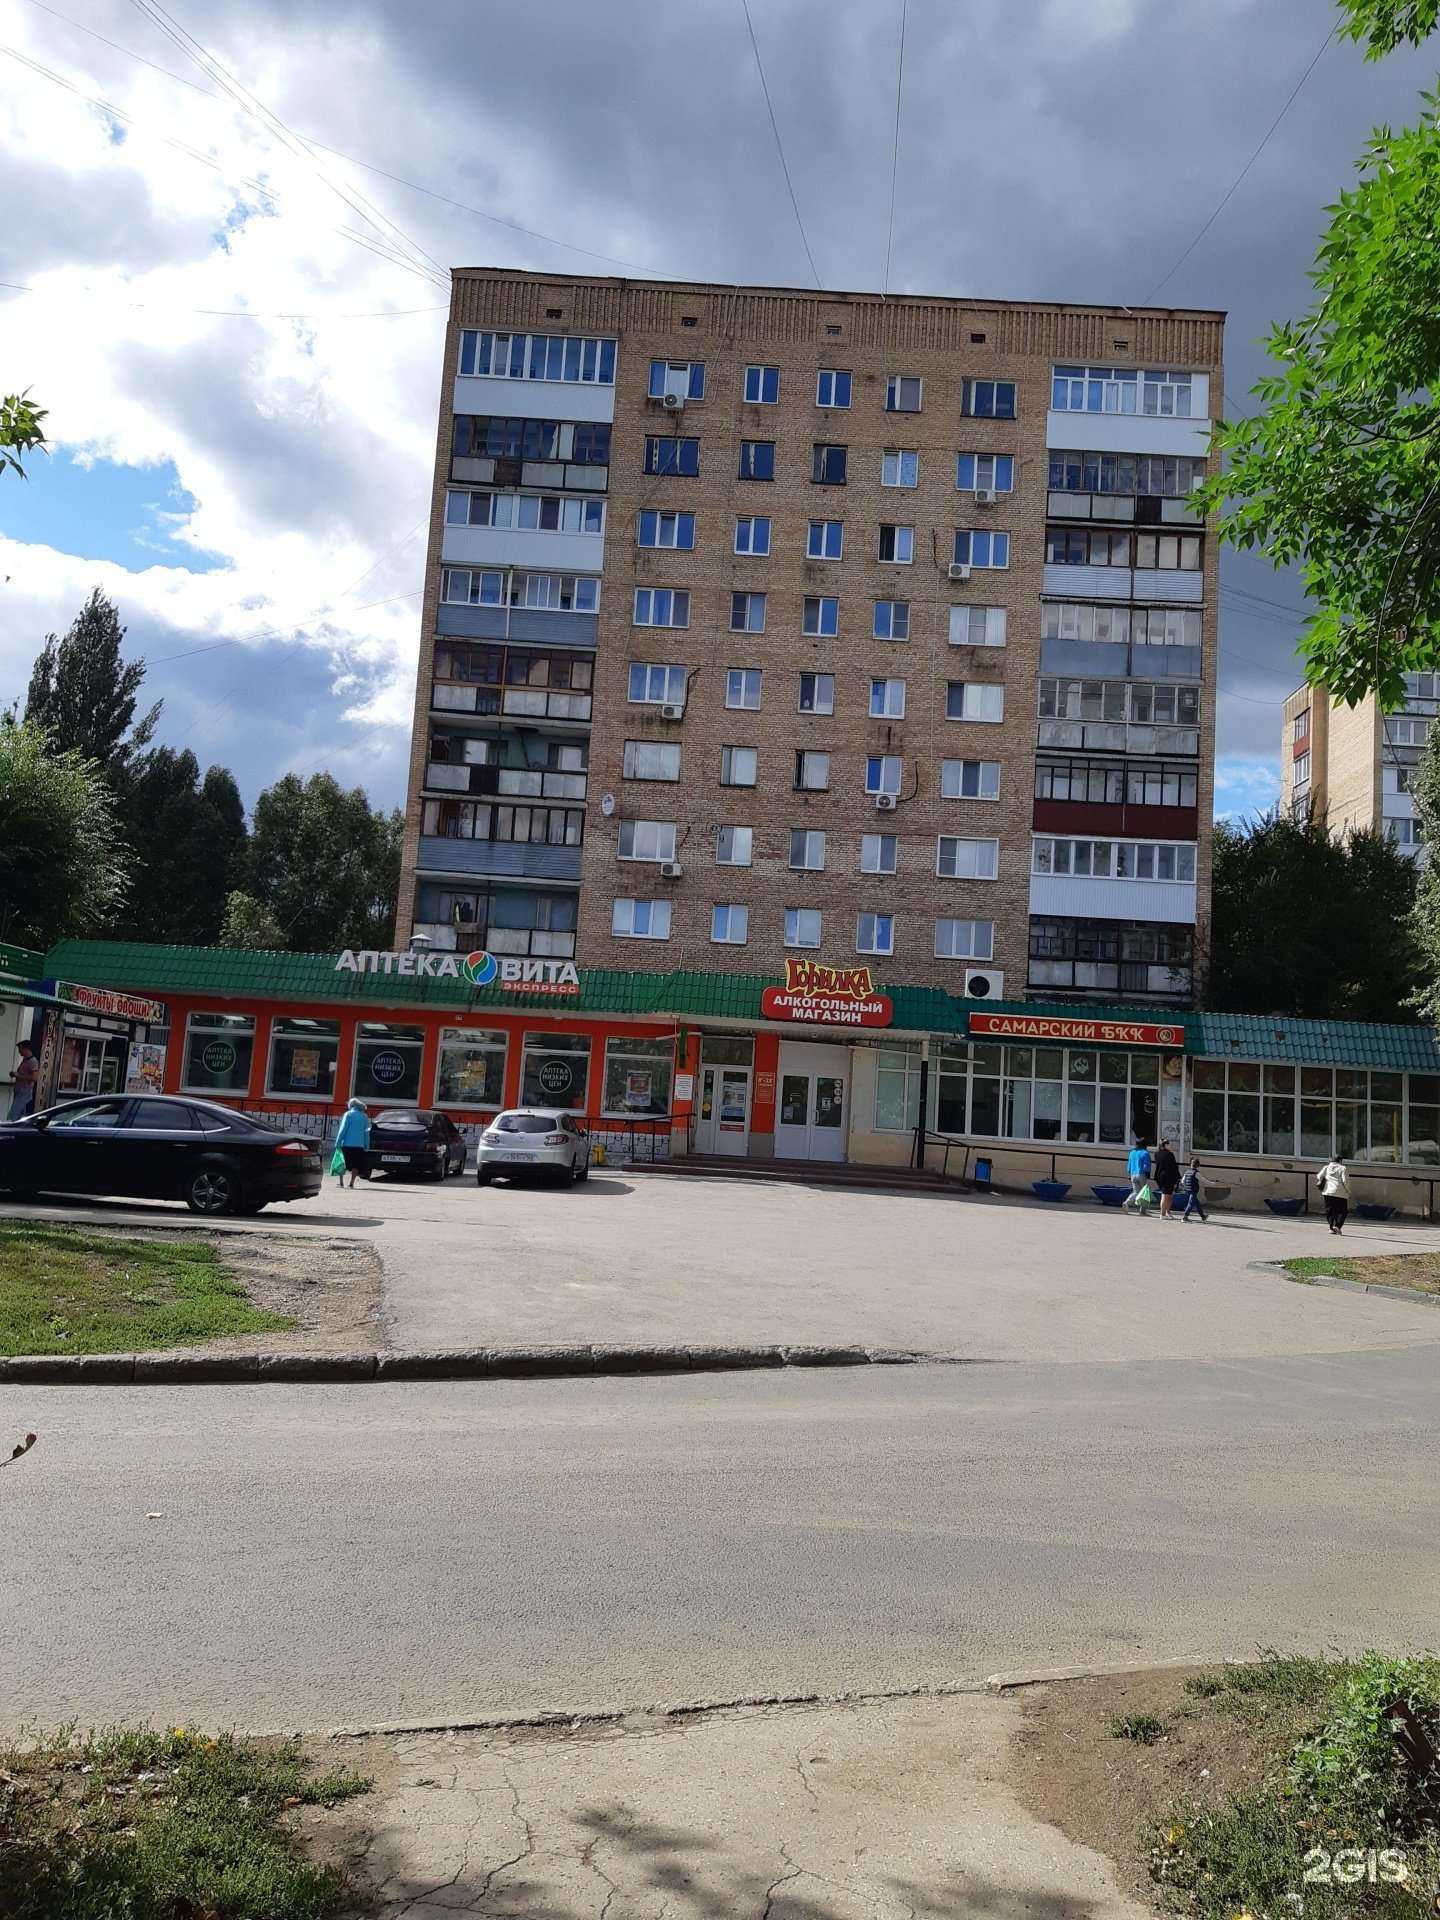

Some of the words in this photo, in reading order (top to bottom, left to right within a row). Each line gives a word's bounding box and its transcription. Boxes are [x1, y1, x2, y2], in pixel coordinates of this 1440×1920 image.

[335, 950, 459, 977] АПТЕКА
[501, 959, 579, 984] ВИТА
[503, 982, 577, 993] ЭКСПРЕСС
[80, 990, 114, 1012] ФРУКТЫ
[773, 995, 883, 1013] АЛКОГОЛЬНЫЙ
[792, 1007, 862, 1023] МАГАЗИН
[988, 1018, 1095, 1038] САМАРСКИЙ
[1101, 1026, 1144, 1041] БКК
